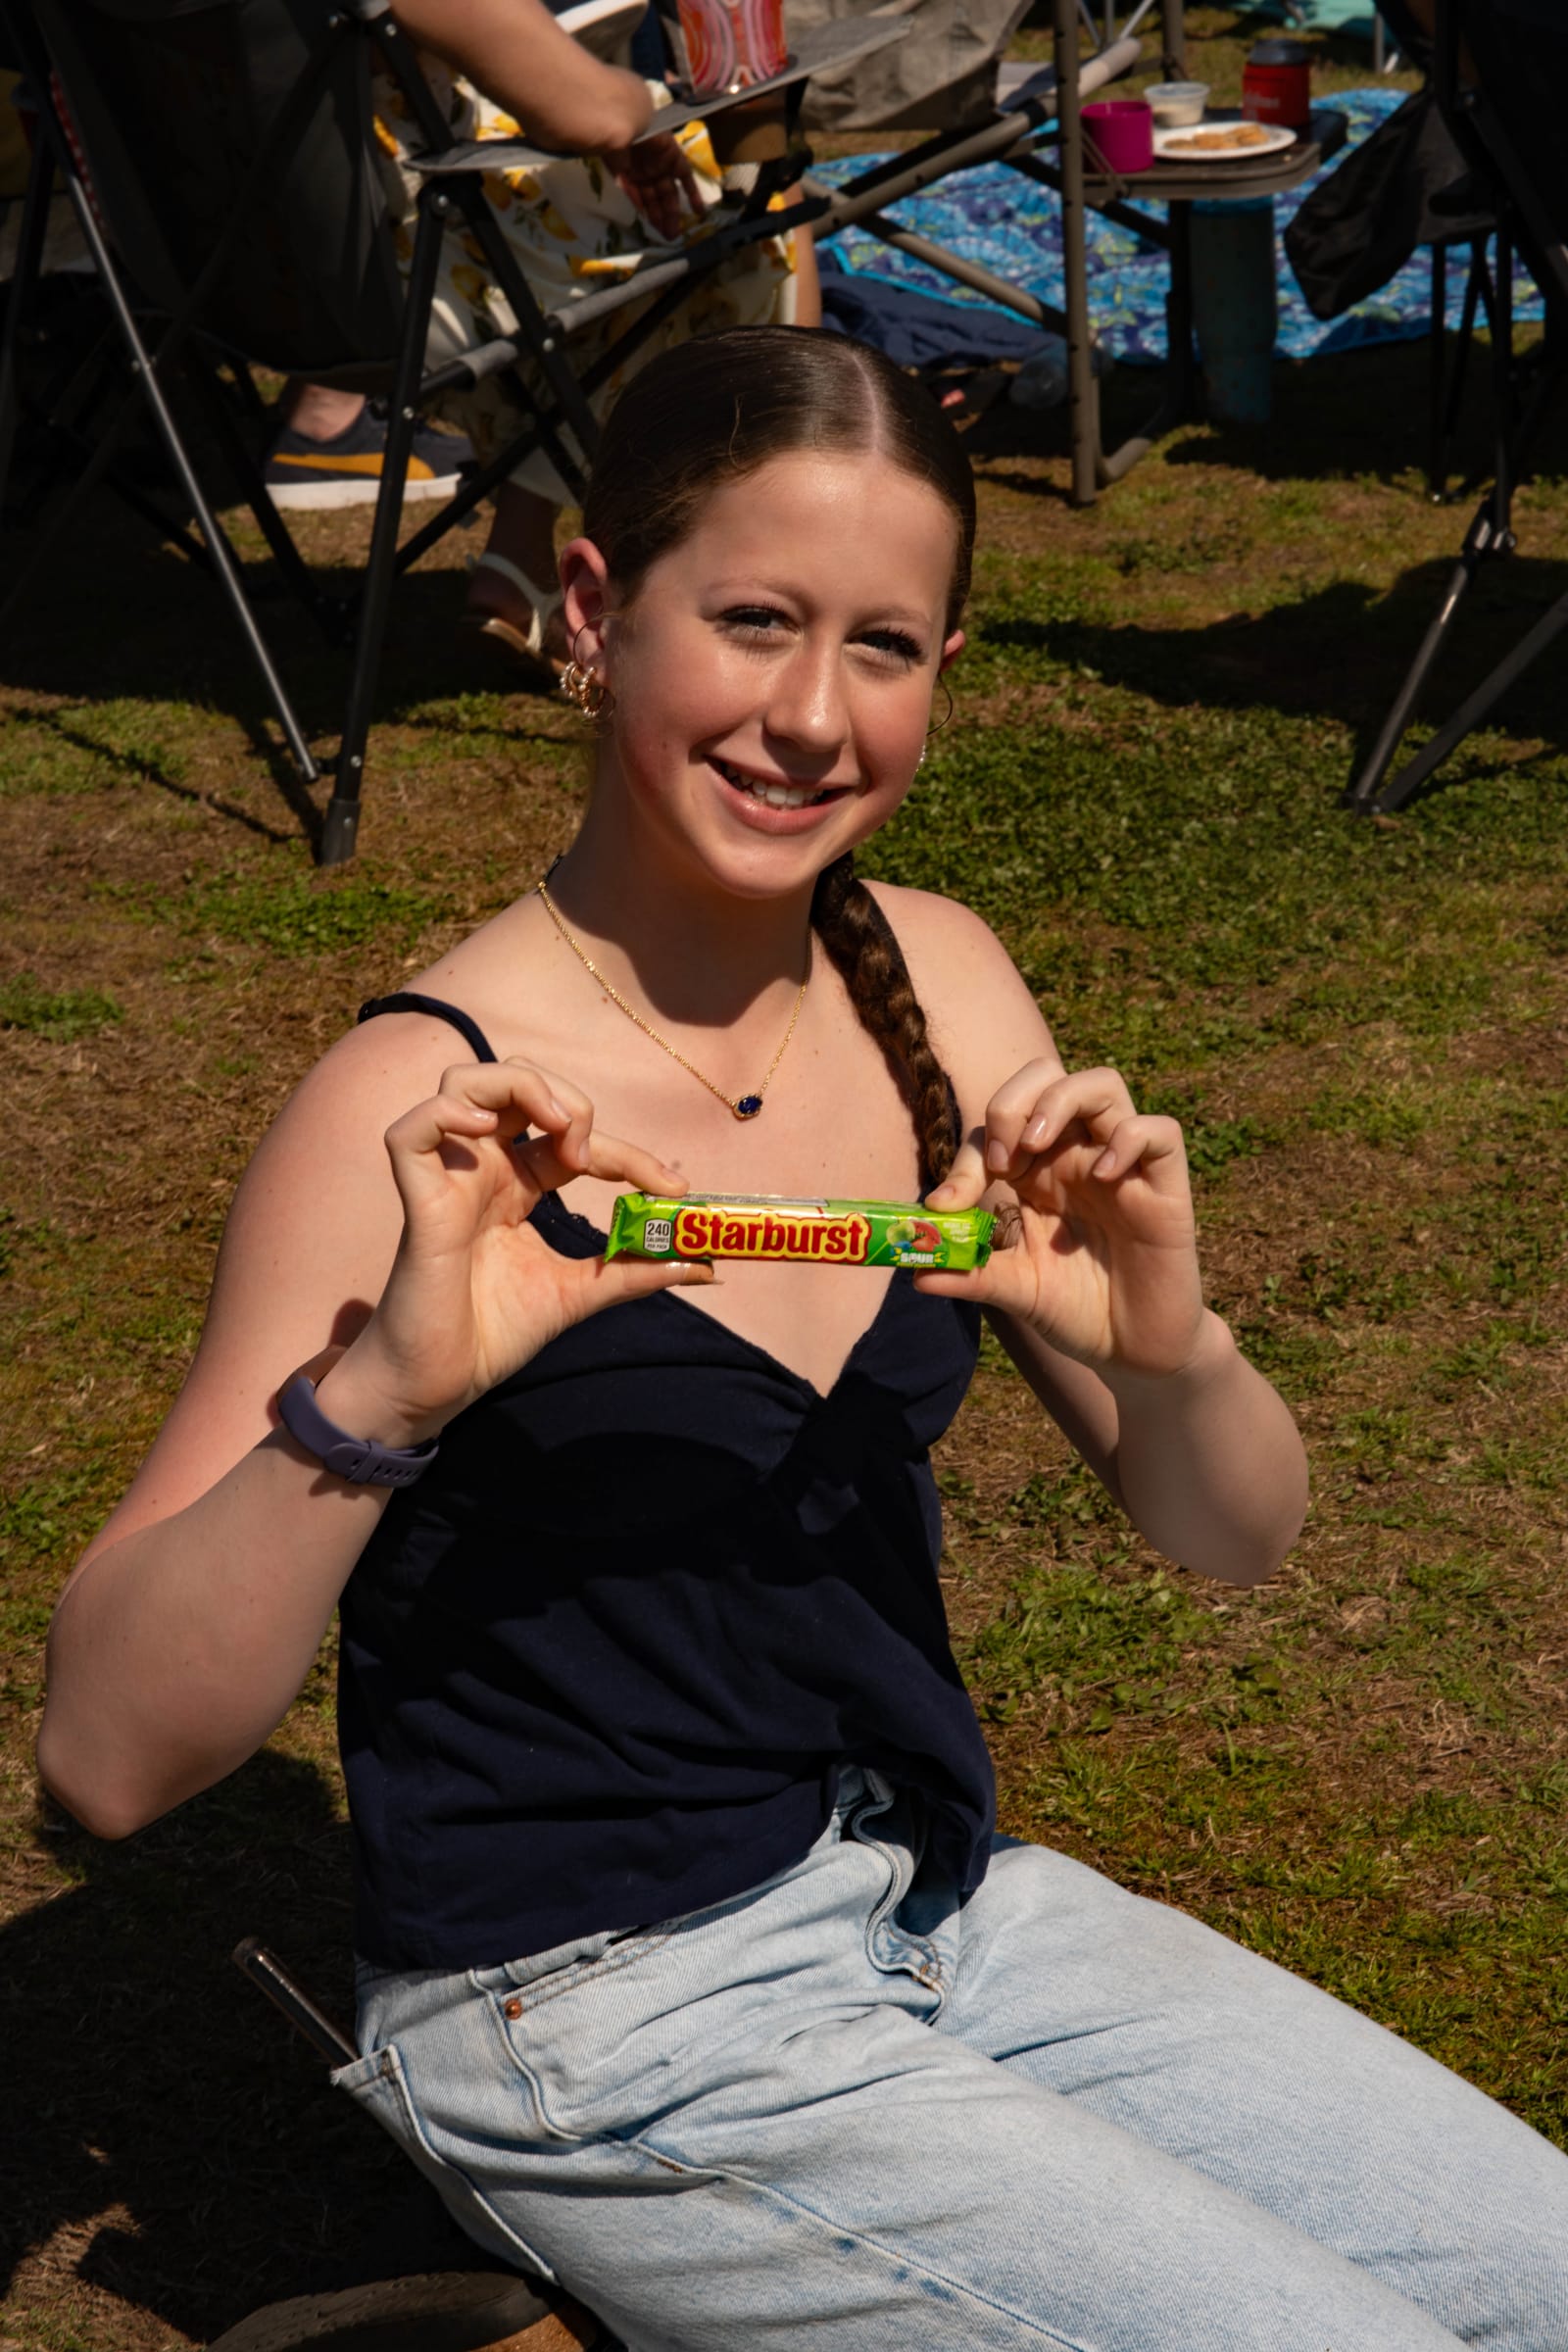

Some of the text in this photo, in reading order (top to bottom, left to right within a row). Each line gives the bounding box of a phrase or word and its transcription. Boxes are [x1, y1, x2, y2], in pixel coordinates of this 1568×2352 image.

[647, 1222, 670, 1237] 240
[682, 1212, 863, 1255] Starburst
[900, 1251, 934, 1264] SOUR
